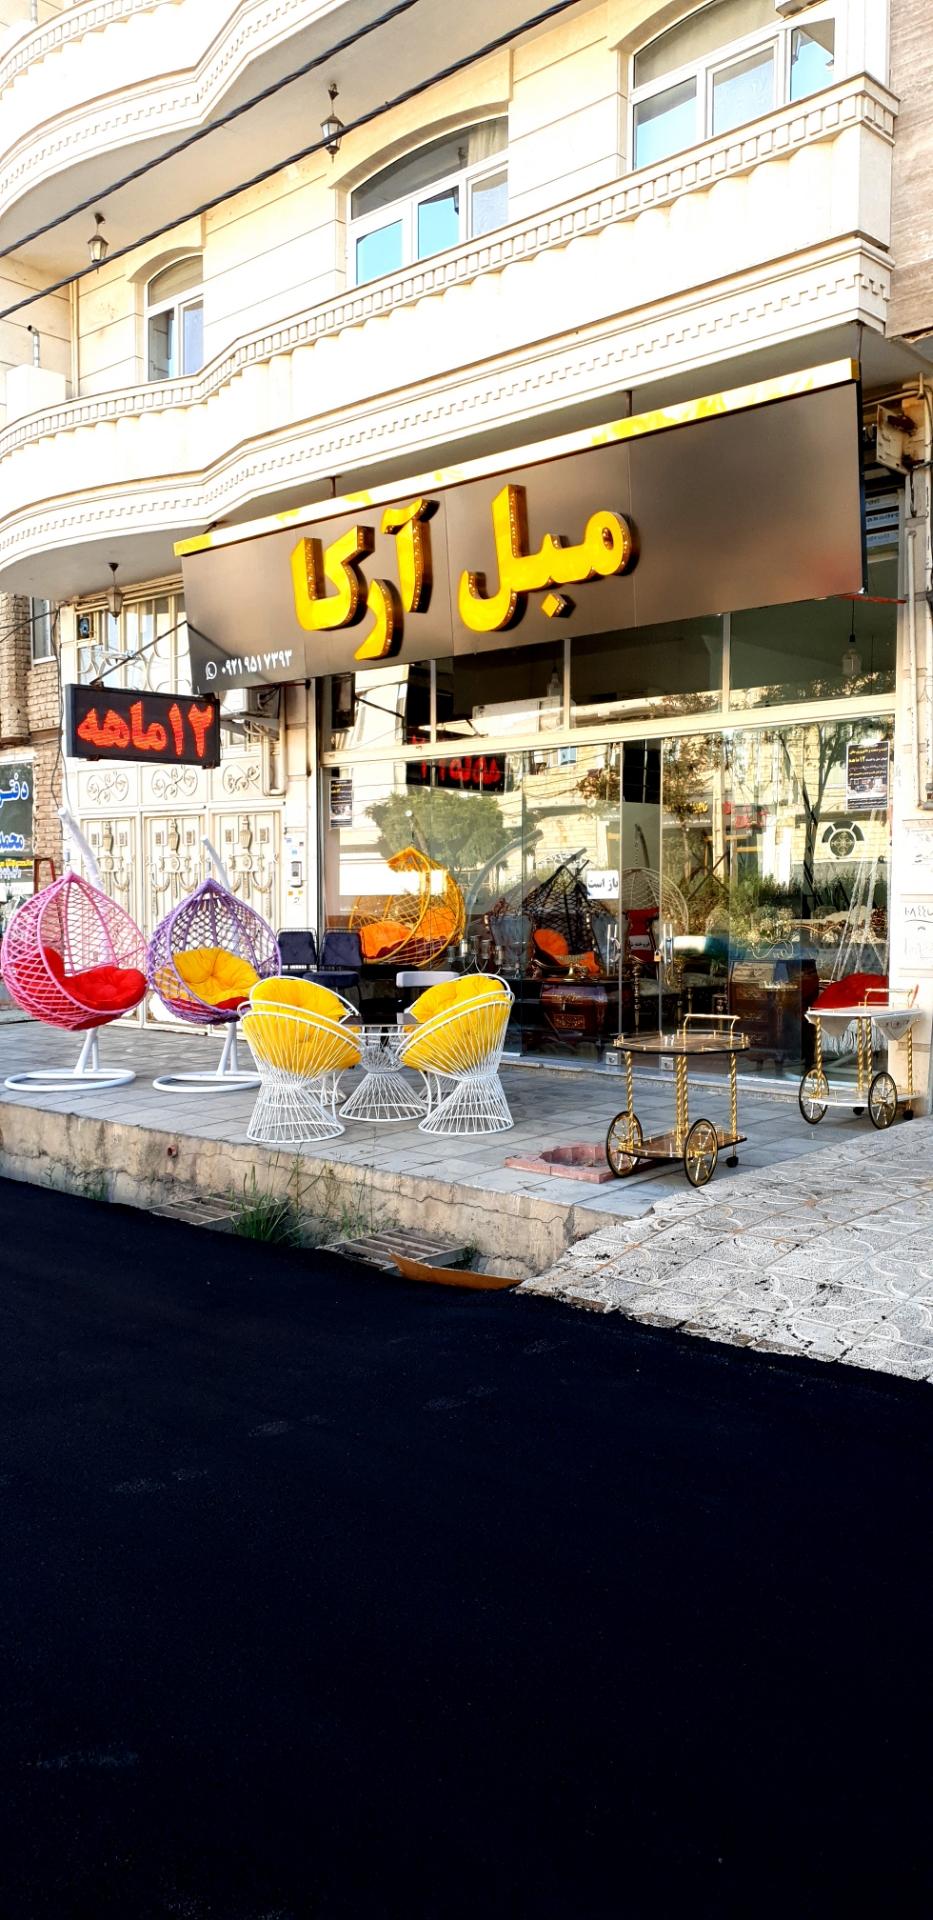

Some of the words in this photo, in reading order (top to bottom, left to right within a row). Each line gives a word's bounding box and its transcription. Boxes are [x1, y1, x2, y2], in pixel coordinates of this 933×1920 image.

[291, 498, 439, 661] آرکا
[458, 484, 638, 632] مبل
[221, 658, 243, 676] ۰۹۲۱
[244, 654, 262, 673] ۹۵۱
[263, 649, 292, 670] ۷۳۹۳
[77, 700, 166, 750] ماهه
[168, 702, 215, 757] ۱۲
